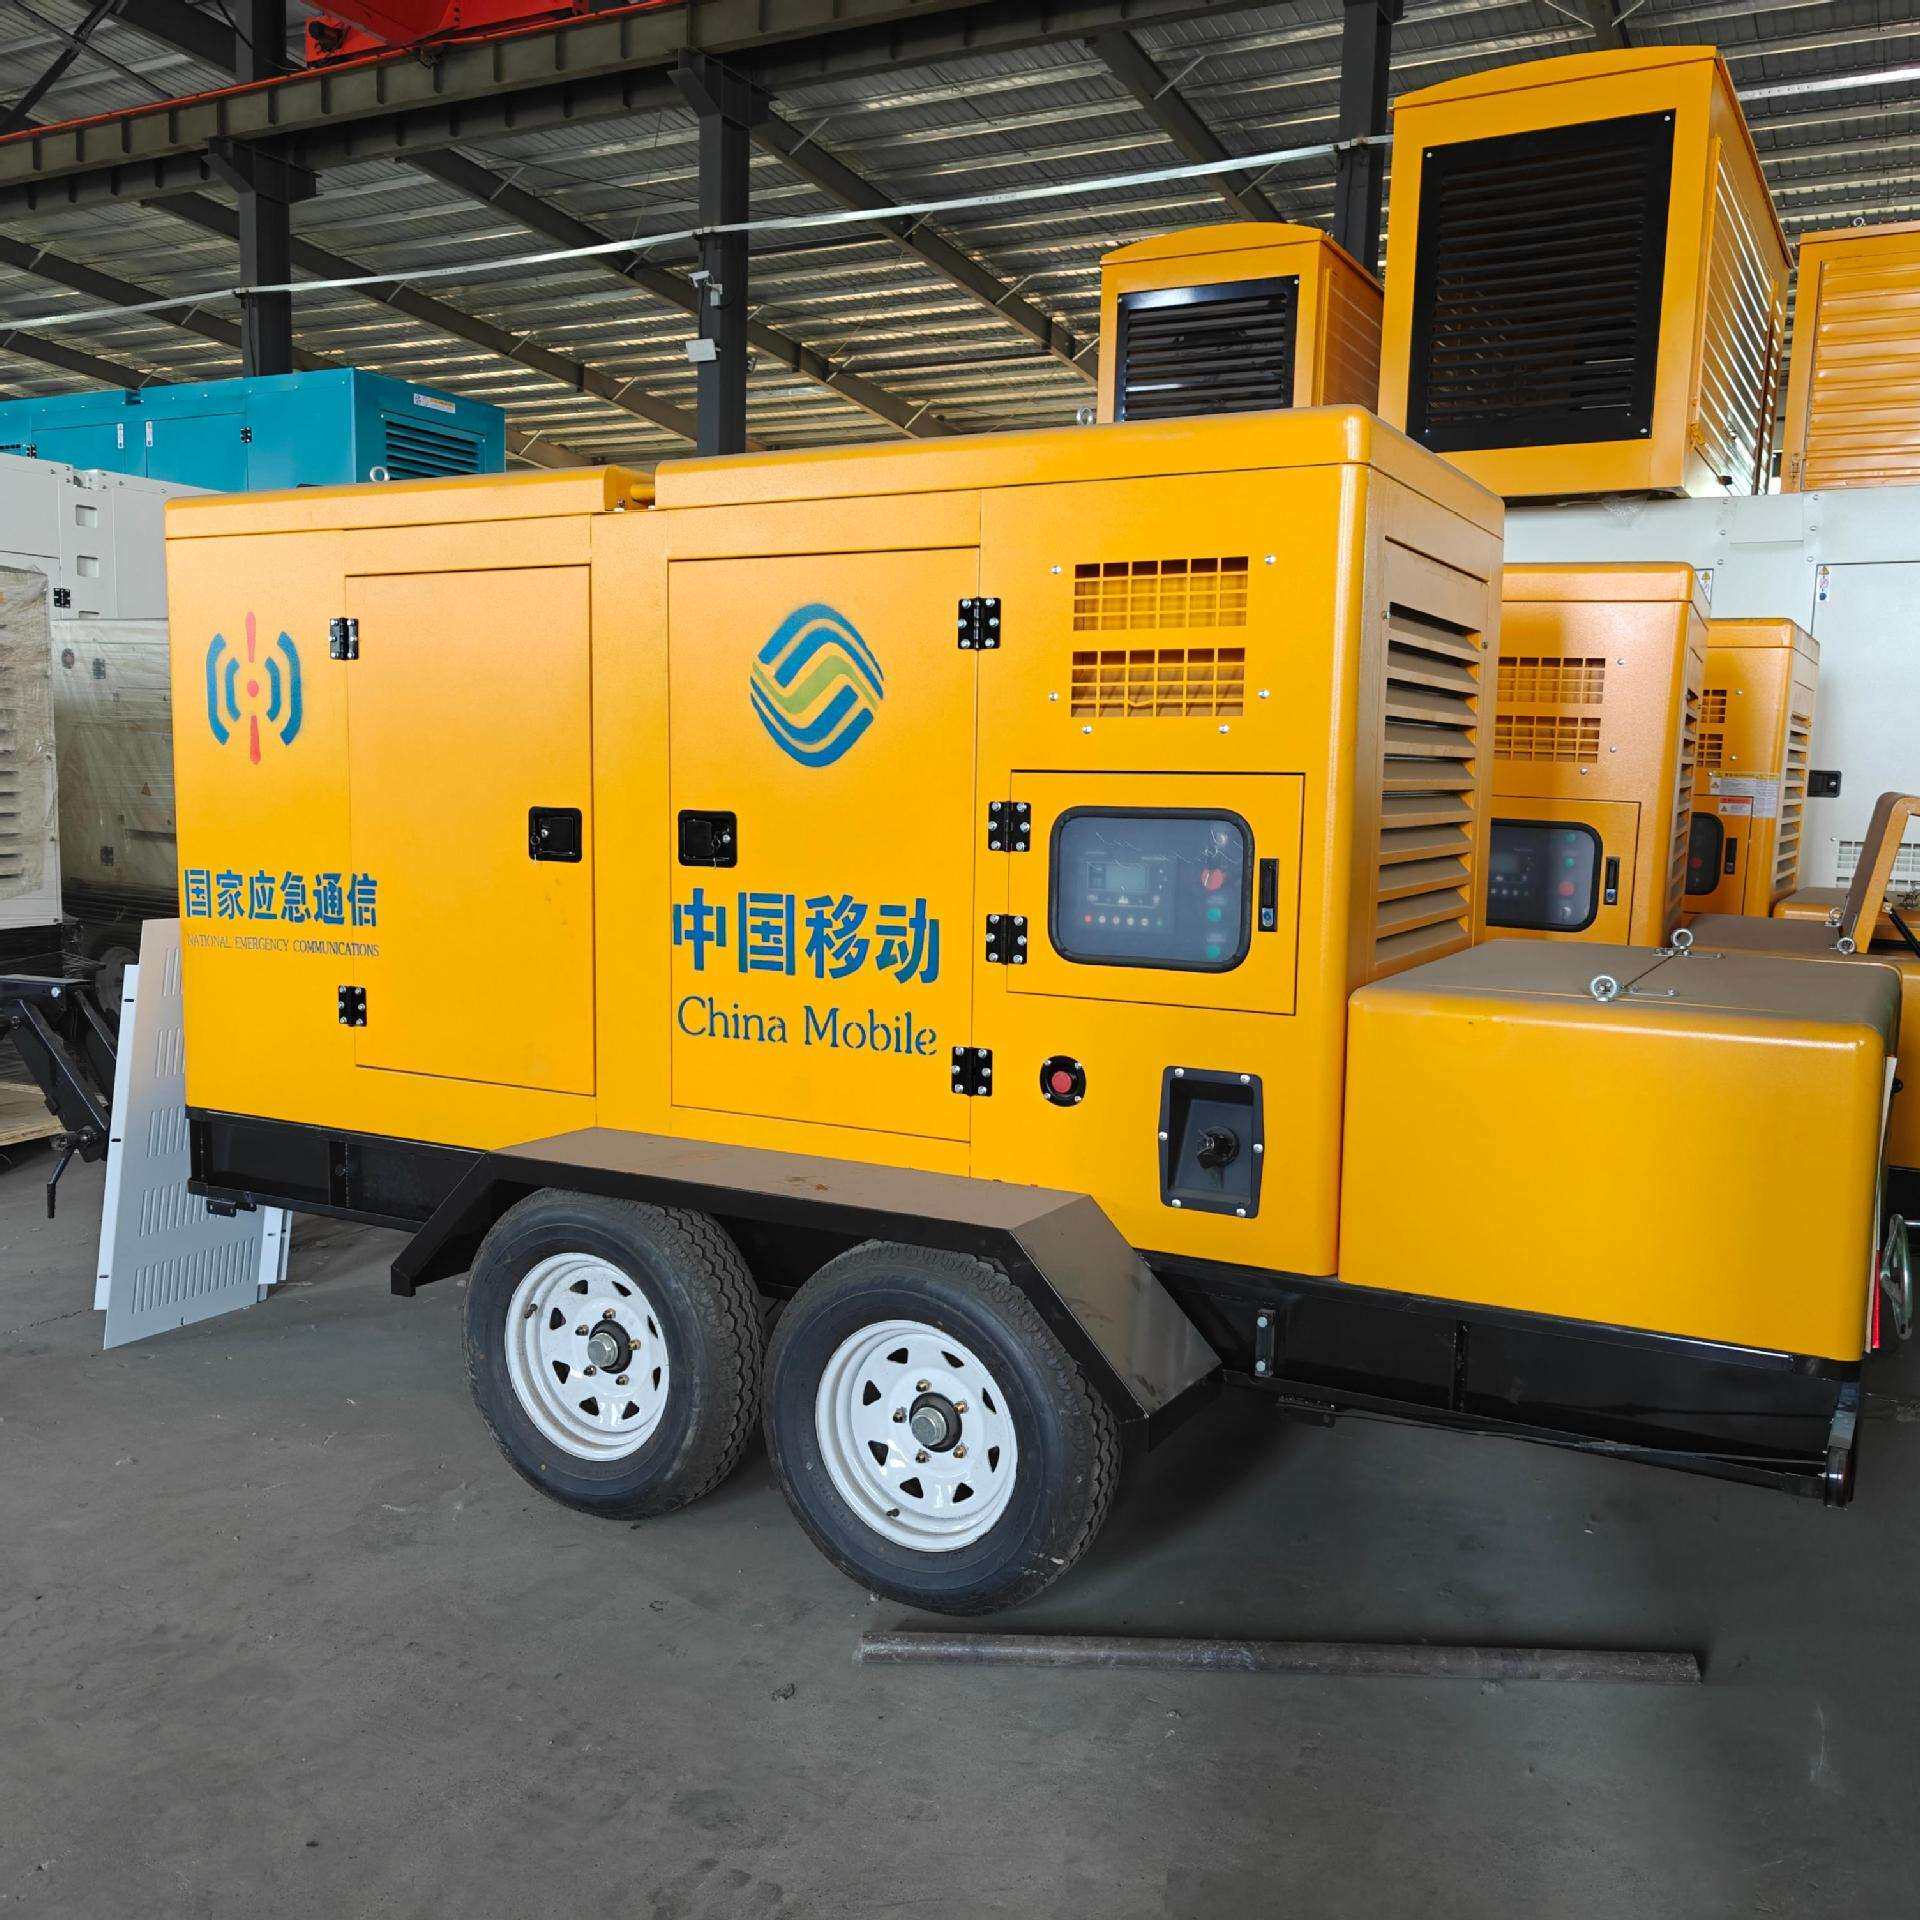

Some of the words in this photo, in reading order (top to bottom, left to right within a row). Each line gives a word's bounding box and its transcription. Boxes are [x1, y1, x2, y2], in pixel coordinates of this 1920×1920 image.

[184, 870, 377, 926] 国家应急通信
[187, 934, 231, 949] NATIONAL
[234, 936, 290, 952] EMERGENCY
[293, 939, 380, 957] COMMUNICATIONS
[672, 887, 940, 984] 中国移动
[677, 995, 788, 1043] China
[803, 1004, 937, 1056] Mobile
